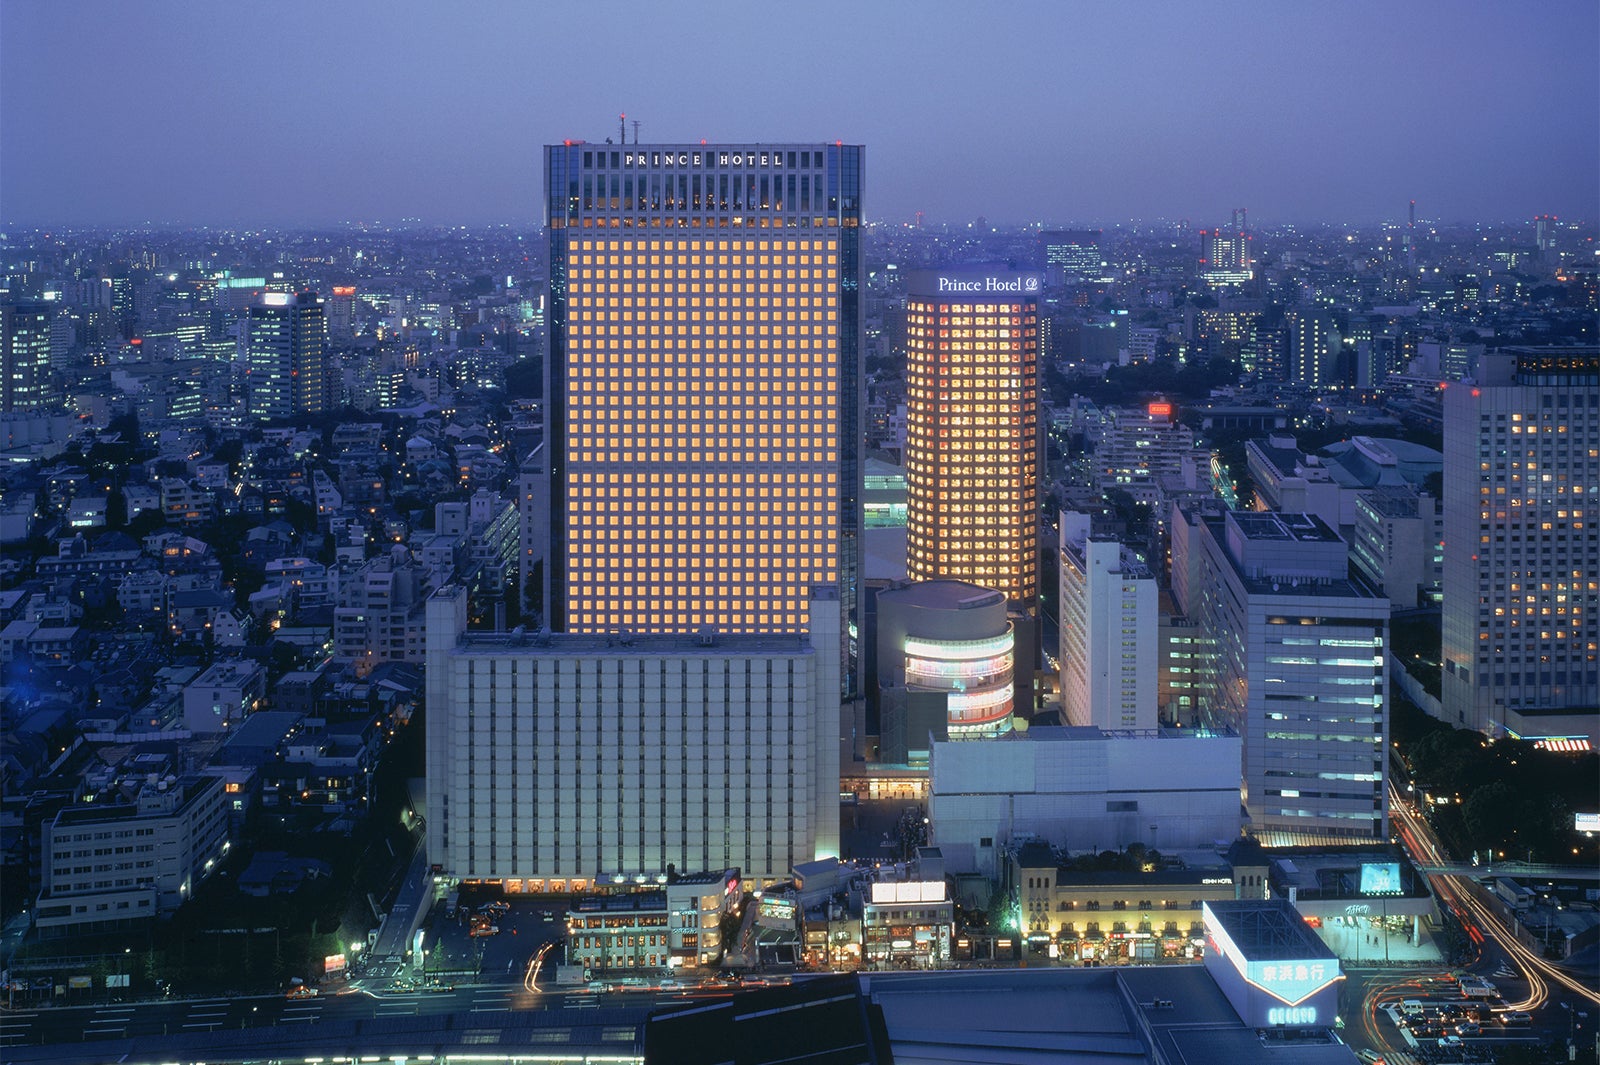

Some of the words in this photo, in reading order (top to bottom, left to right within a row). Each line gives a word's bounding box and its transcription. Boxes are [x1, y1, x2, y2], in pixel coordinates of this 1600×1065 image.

[625, 155, 701, 166] PRINCE
[719, 155, 782, 166] HOTEL
[939, 277, 982, 292] Prince
[986, 277, 1021, 292] Hotel
[1264, 964, 1324, 981] 京浜急行
